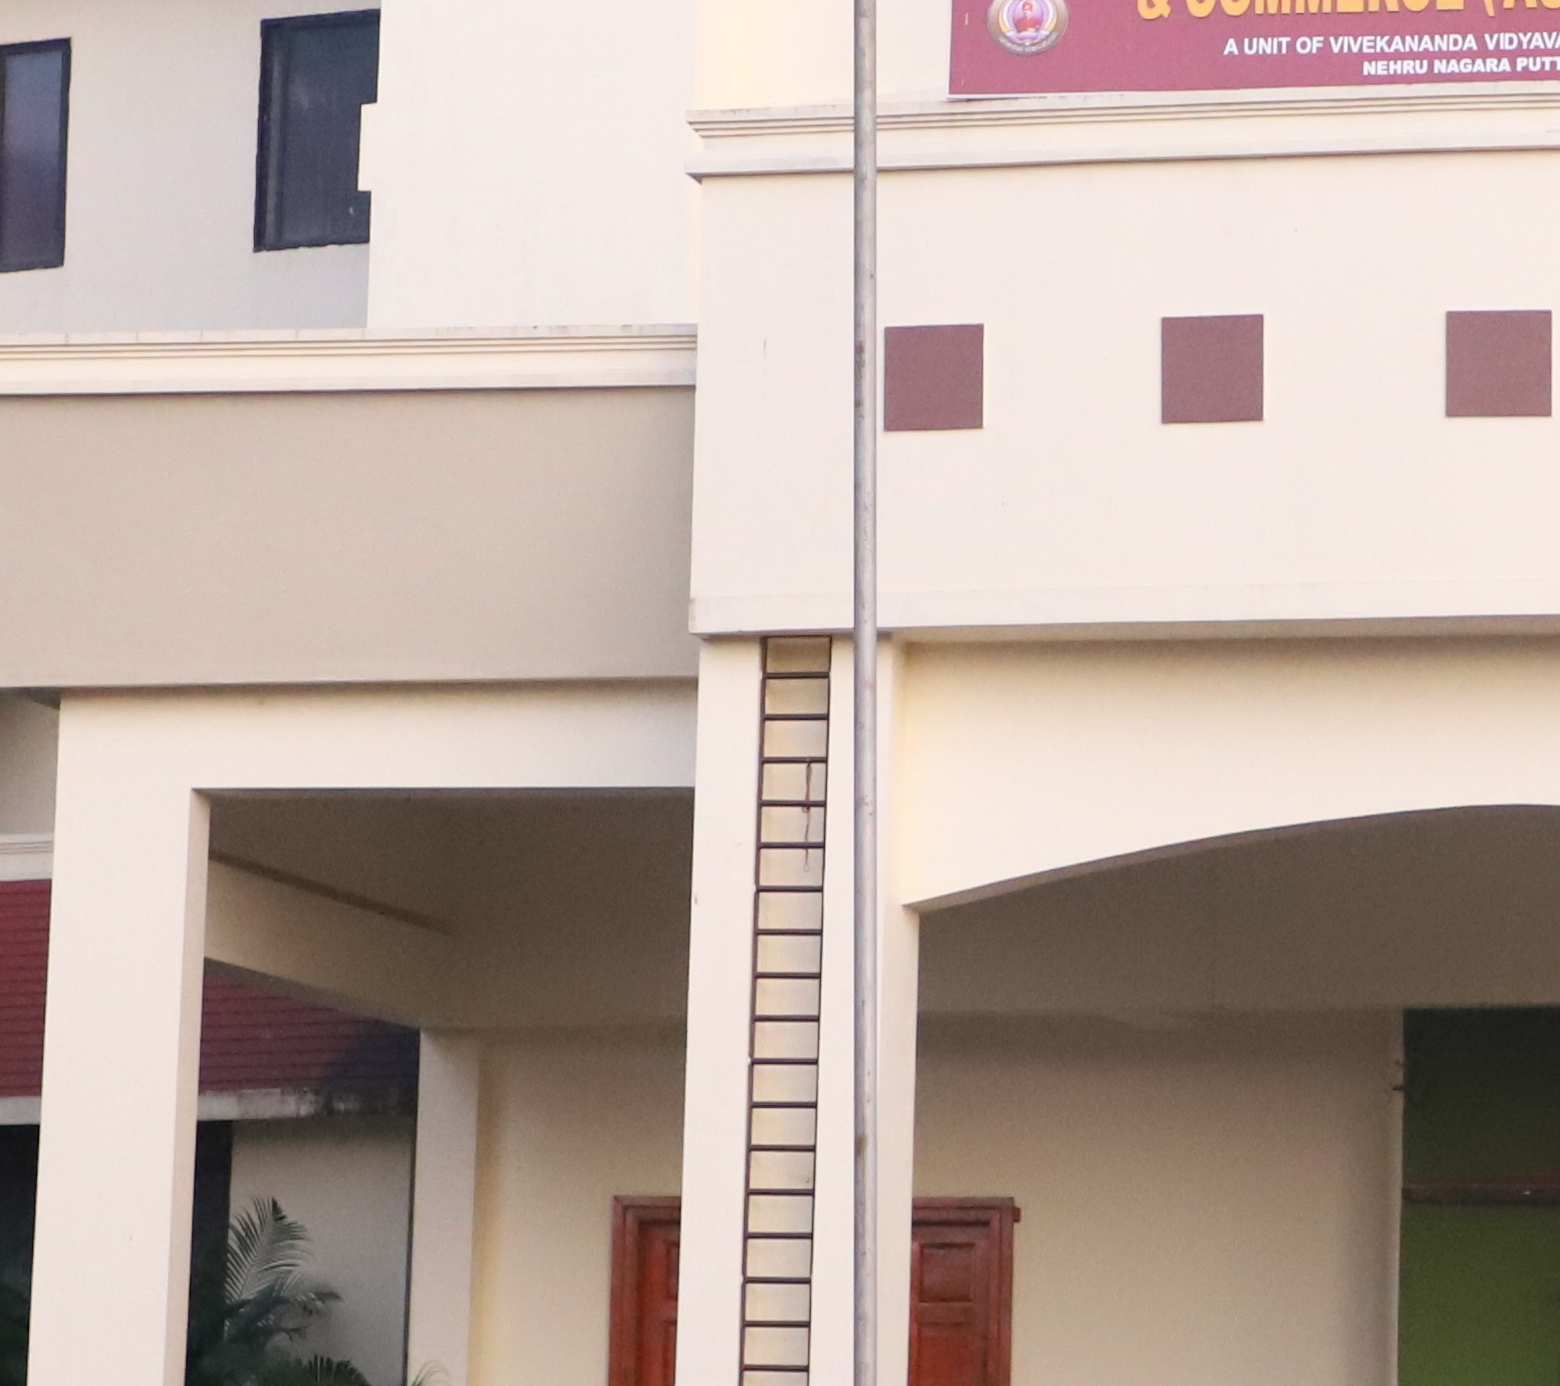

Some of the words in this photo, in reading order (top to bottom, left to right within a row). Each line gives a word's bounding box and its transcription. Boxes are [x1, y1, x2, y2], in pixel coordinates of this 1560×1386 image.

[1223, 38, 1239, 55] A
[1243, 36, 1291, 55] UNIT
[1295, 36, 1324, 54] OF
[1329, 33, 1478, 54] VIVEKANANDA
[1363, 59, 1428, 76] NEHRU
[1433, 57, 1512, 74] NAGARA
